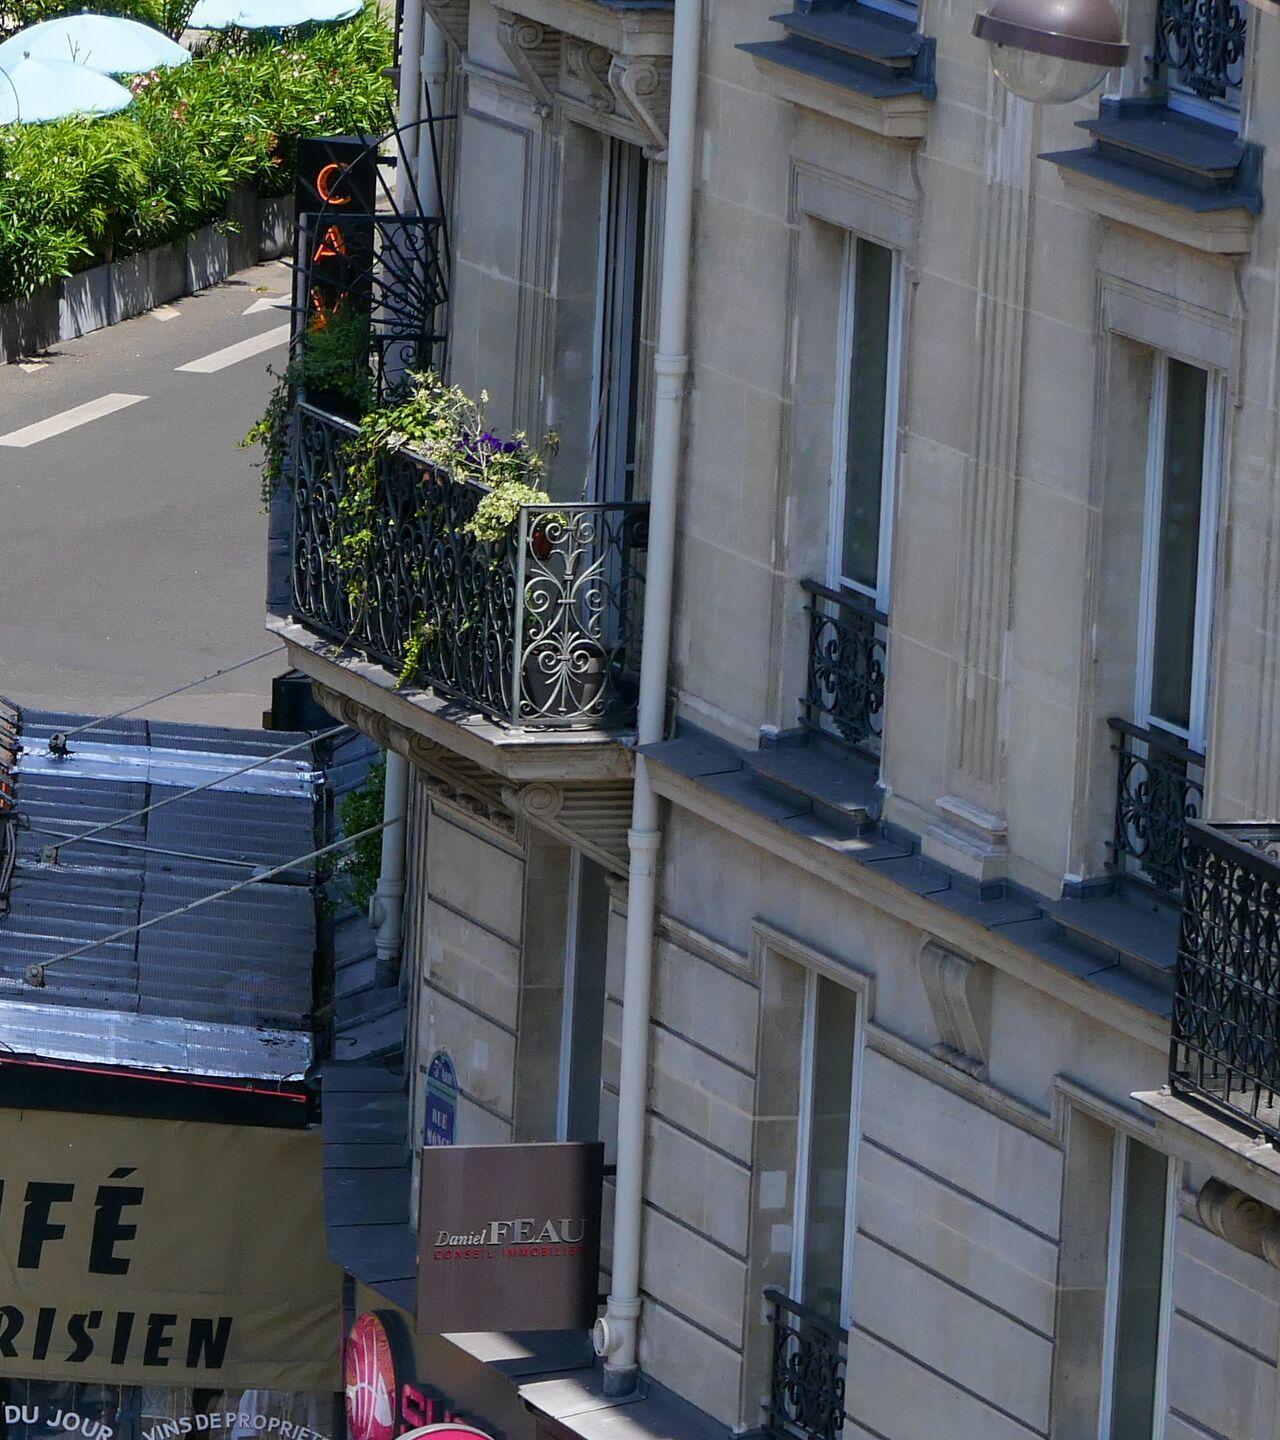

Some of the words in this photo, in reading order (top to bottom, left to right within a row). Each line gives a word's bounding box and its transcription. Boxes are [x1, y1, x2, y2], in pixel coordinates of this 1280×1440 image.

[434, 1229, 486, 1246] Daniel
[434, 1247, 493, 1260] CONSEIL
[4, 1405, 40, 1425] DU
[195, 1412, 221, 1432] DE
